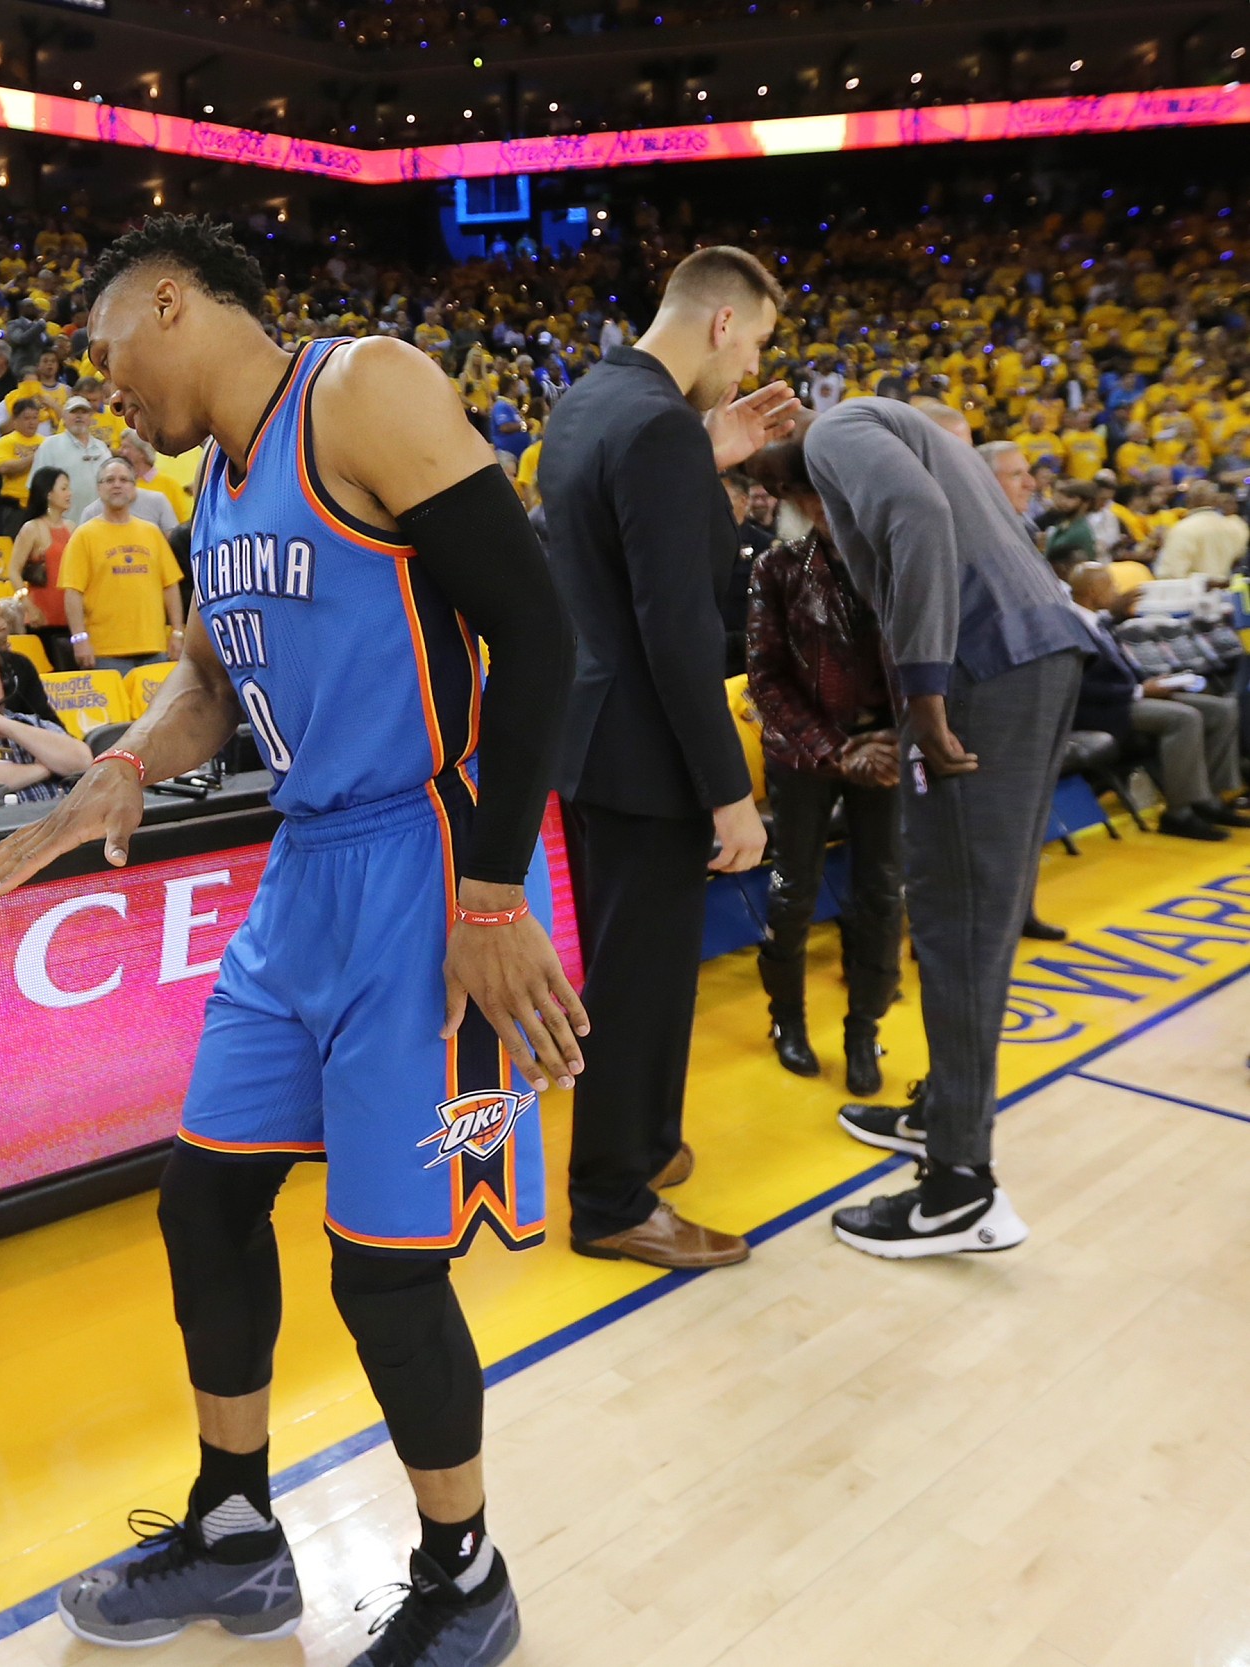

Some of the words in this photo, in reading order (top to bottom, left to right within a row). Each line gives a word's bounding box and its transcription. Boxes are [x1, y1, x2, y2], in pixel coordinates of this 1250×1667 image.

[191, 531, 316, 611] KLAHOMA
[211, 607, 269, 669] CITY
[42, 674, 93, 695] trength
[239, 676, 293, 775] 0
[440, 1100, 504, 1151] OKC
